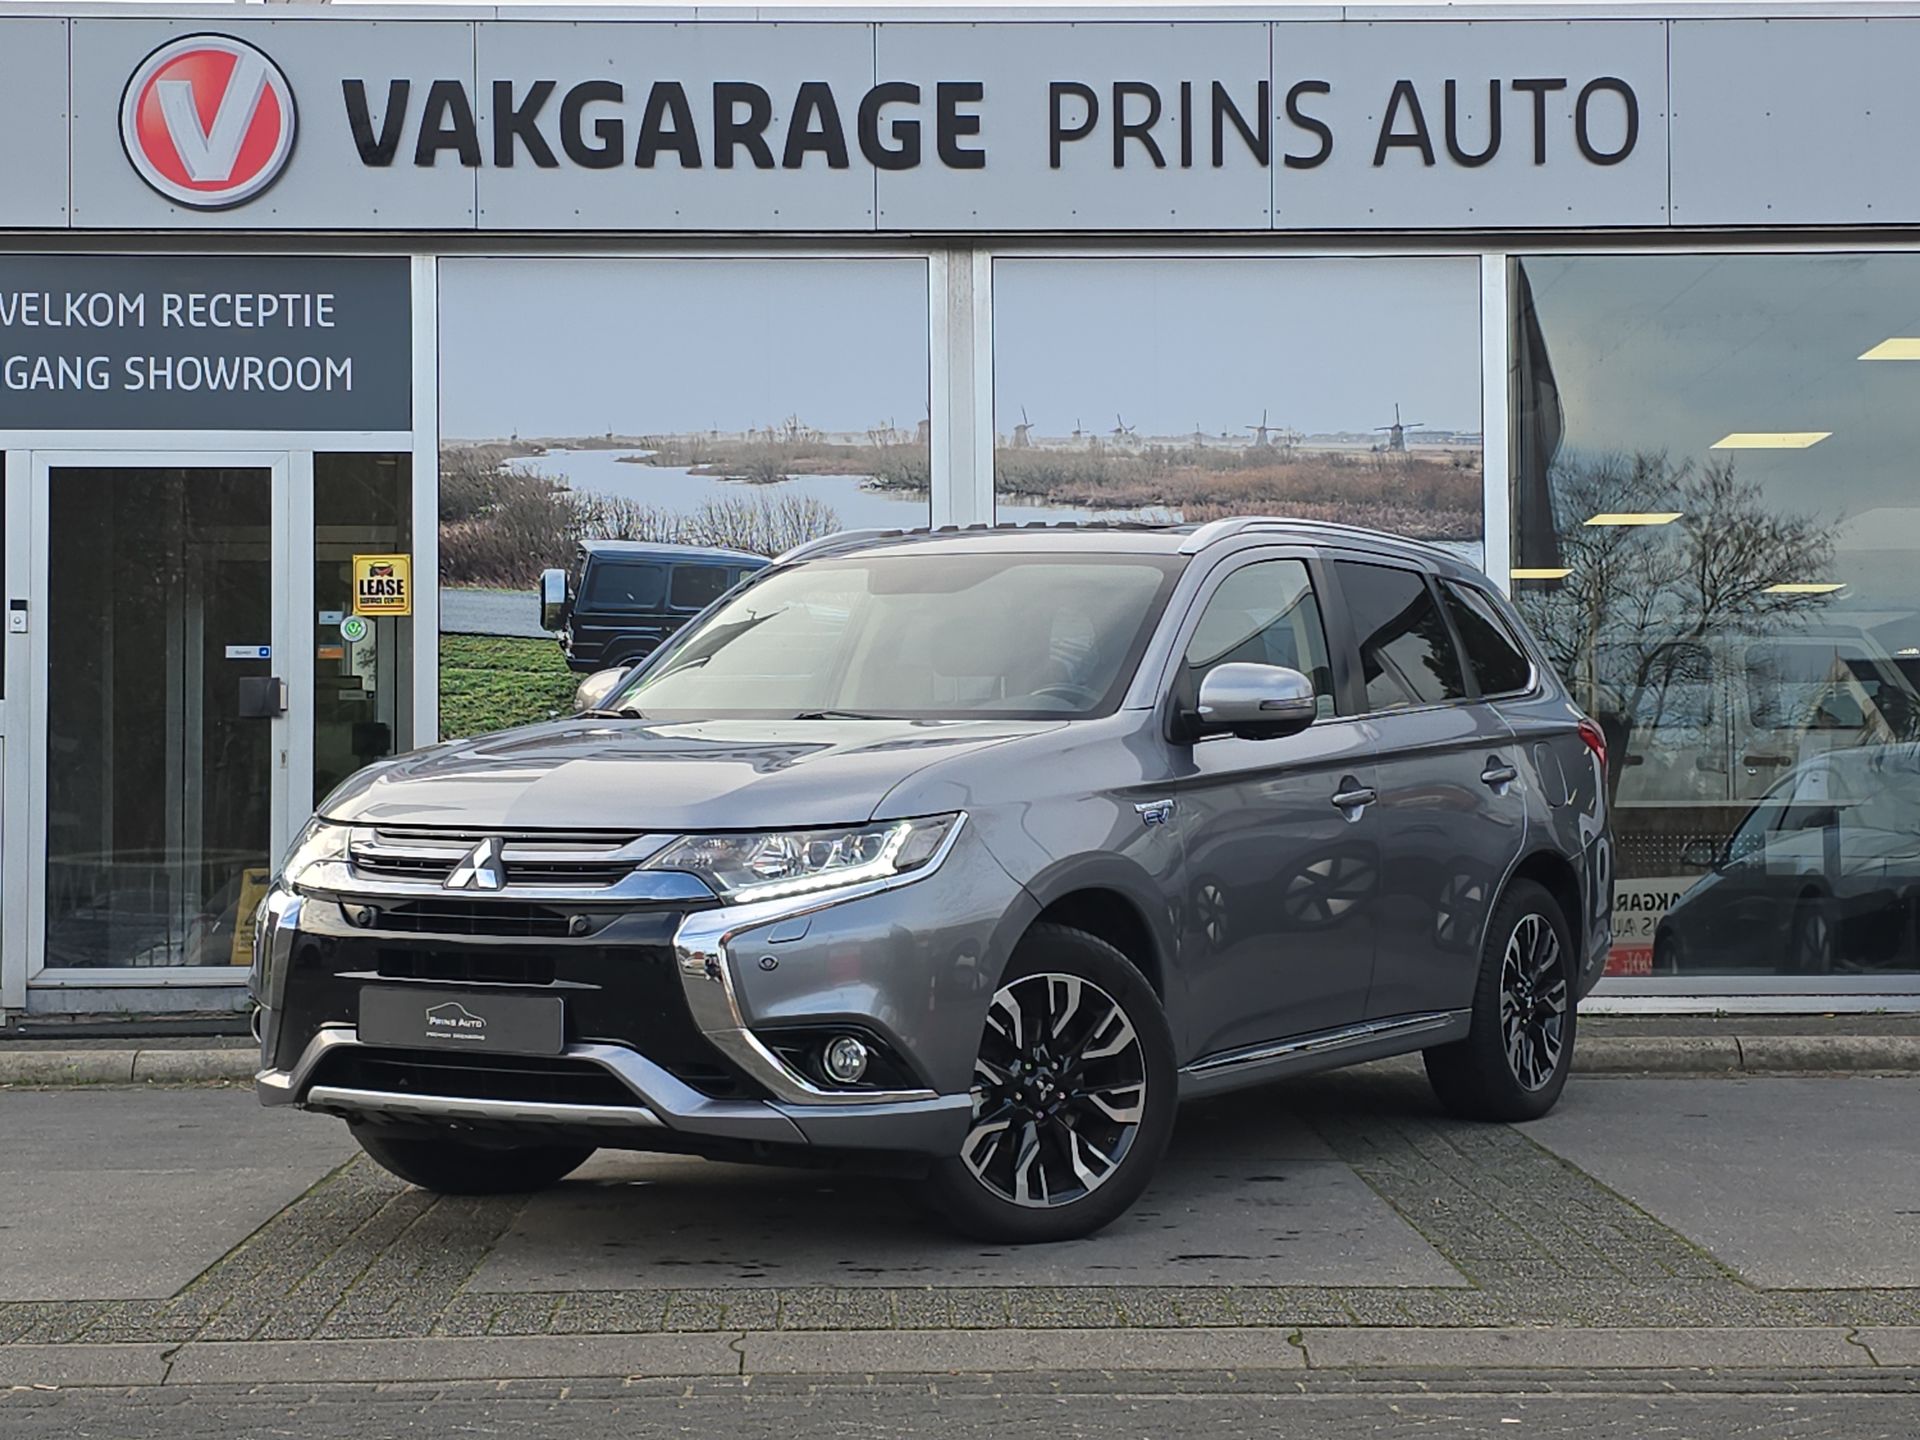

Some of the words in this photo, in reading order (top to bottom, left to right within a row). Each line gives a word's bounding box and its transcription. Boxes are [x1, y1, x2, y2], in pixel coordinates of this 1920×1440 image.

[342, 80, 985, 169] VAKGARAGE
[1050, 80, 1332, 169] PRINS
[1373, 77, 1638, 168] AUTO
[162, 293, 335, 327] RECEPTIE
[5, 356, 109, 390] GANG
[124, 356, 352, 391] SHOWROOM
[360, 579, 405, 595] LEASE
[429, 1017, 457, 1026] PRINS
[458, 1018, 482, 1028] AUTO
